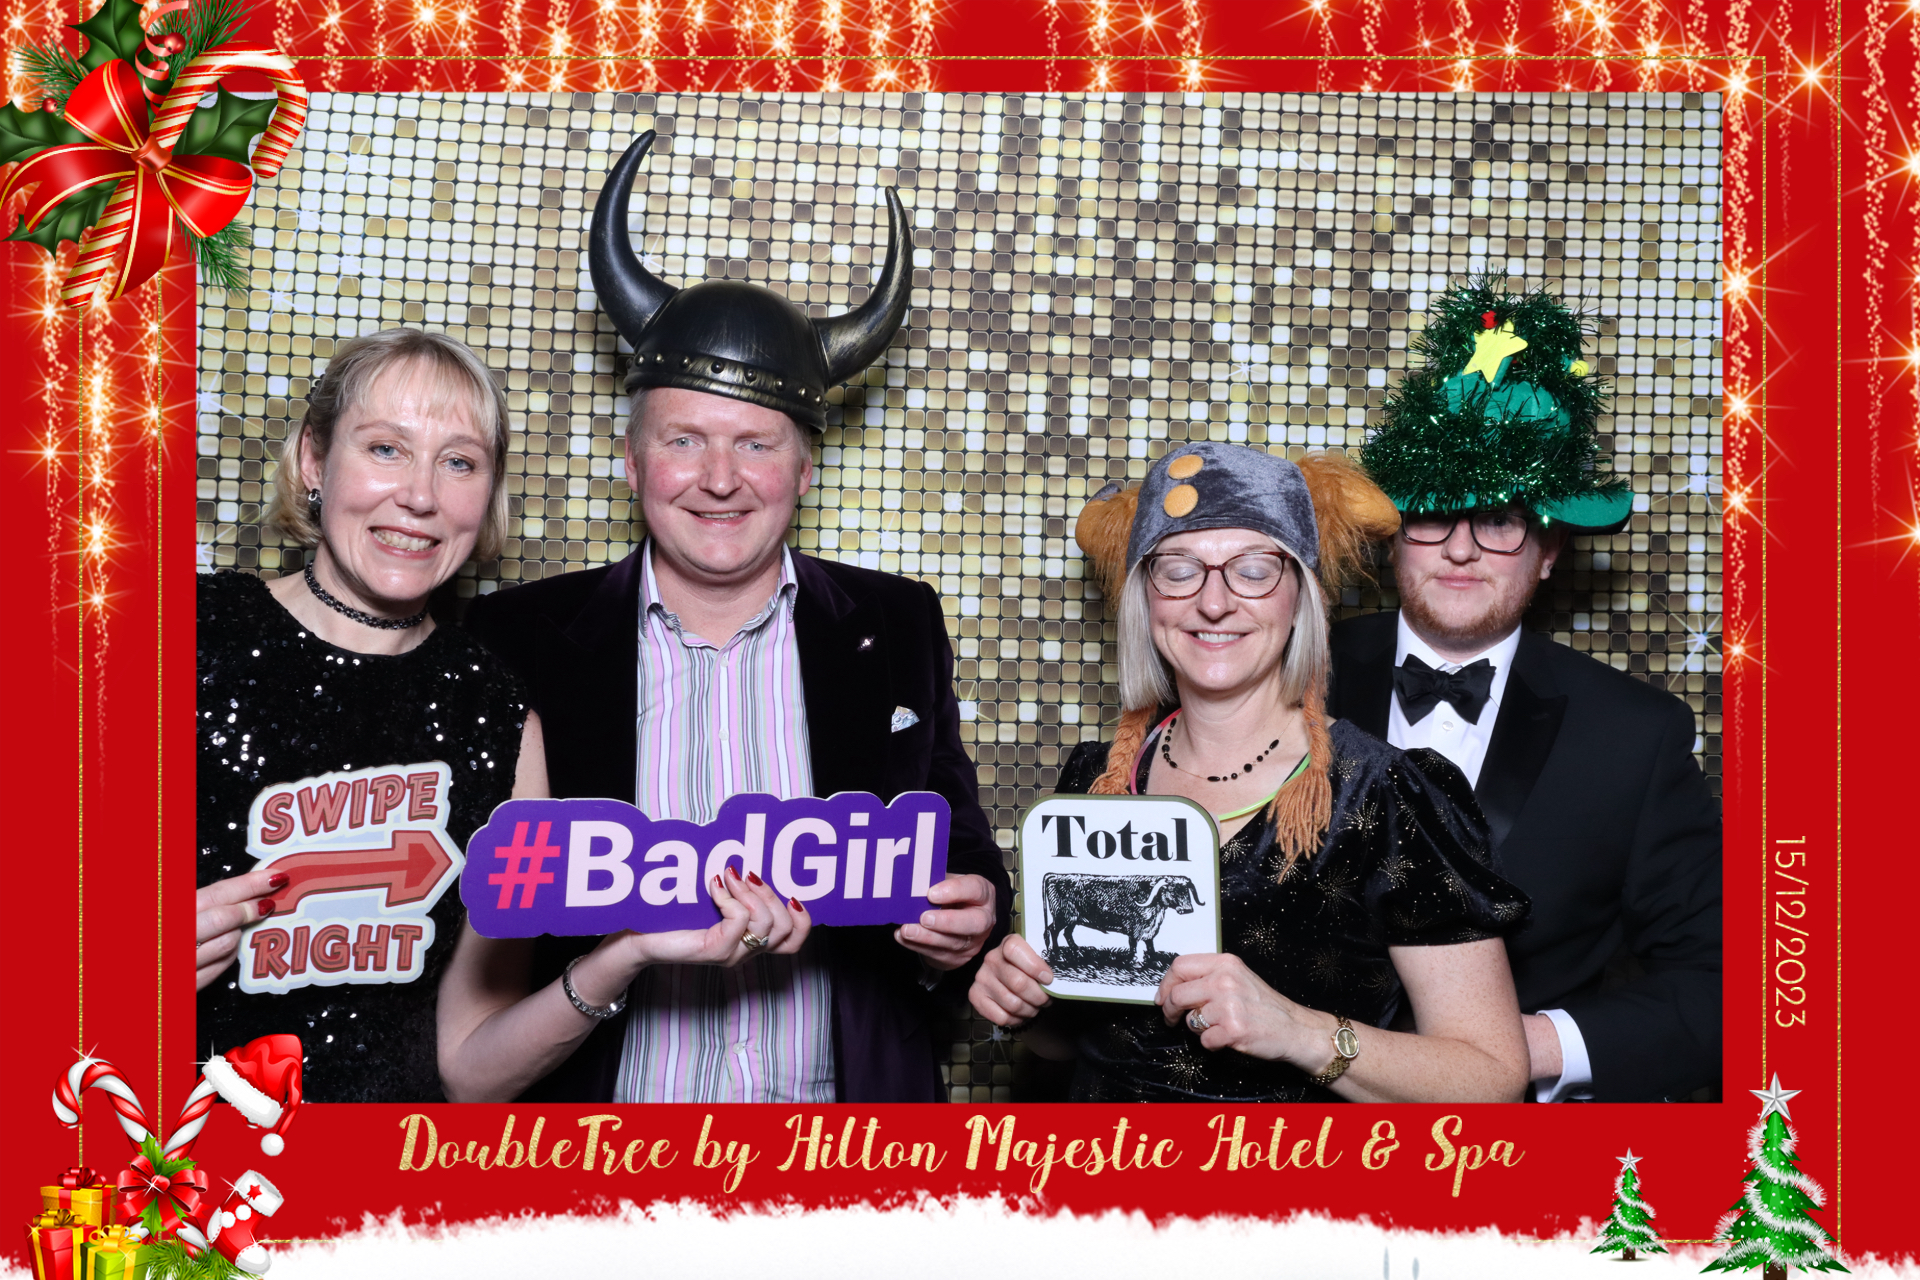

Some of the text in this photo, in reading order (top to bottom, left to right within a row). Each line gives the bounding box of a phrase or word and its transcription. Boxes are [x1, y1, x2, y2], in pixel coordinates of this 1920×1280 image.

[260, 771, 439, 845] SWIPE
[1041, 814, 1192, 862] Total
[488, 811, 936, 910] #BadGirl
[250, 923, 423, 980] RIGHT
